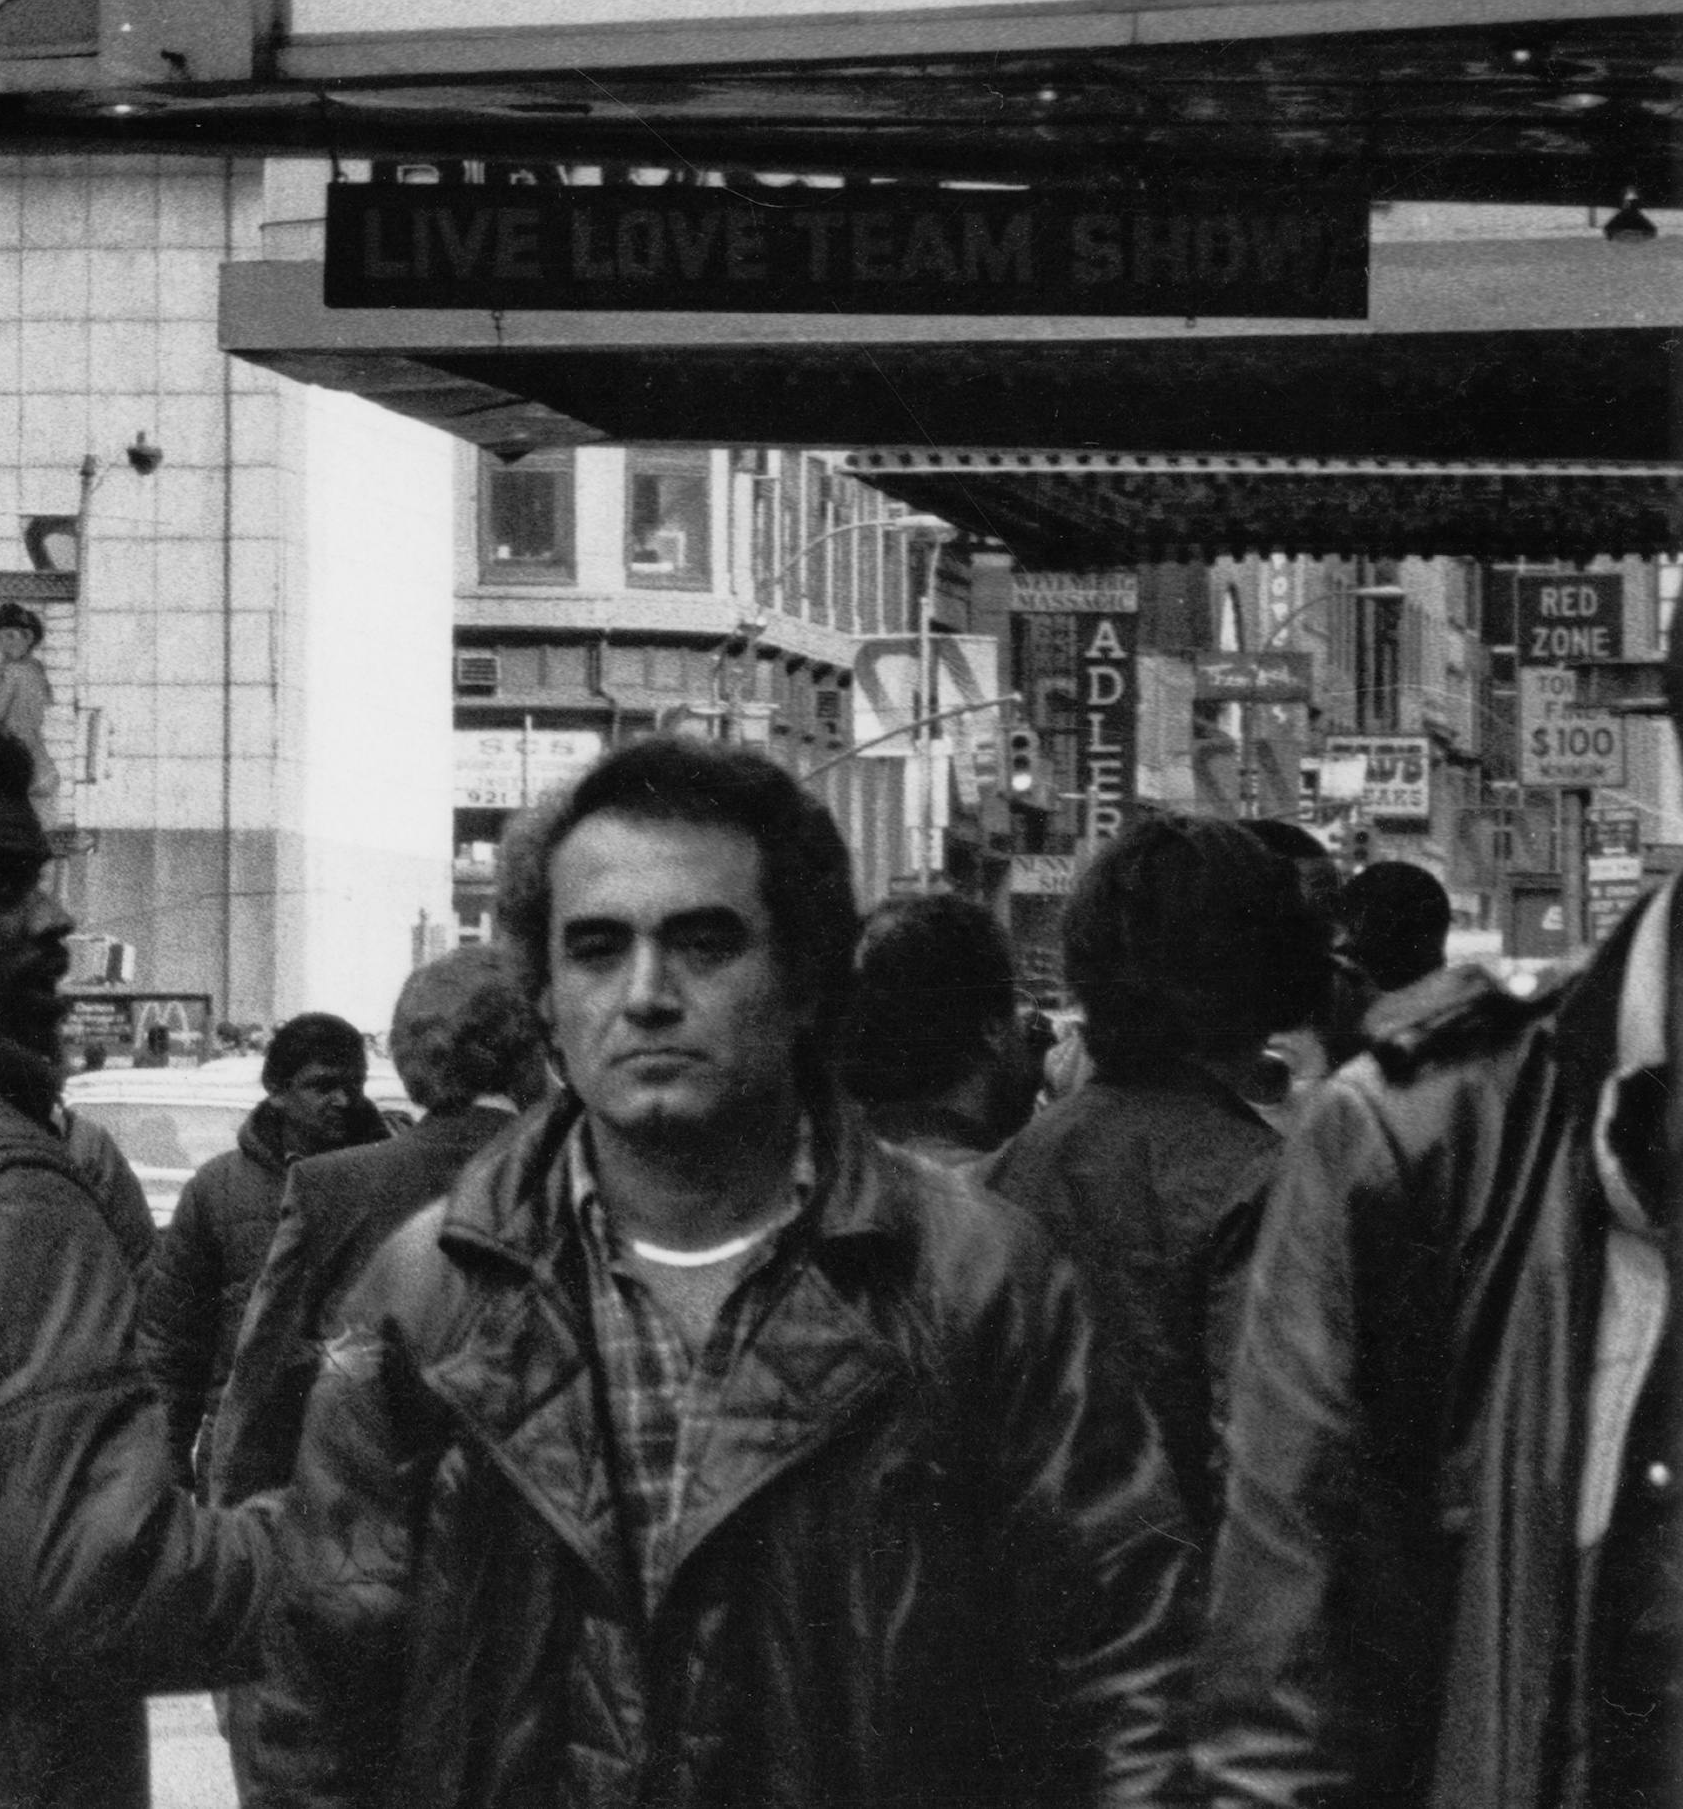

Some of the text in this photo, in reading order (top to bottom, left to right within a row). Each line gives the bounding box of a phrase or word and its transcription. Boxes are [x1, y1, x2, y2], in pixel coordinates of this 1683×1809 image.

[364, 208, 1325, 287] LIVE LOVE TEAM SHOW
[1541, 586, 1598, 616] RED
[1532, 627, 1610, 657] ZONE
[1085, 620, 1127, 838] ADLER
[1532, 727, 1614, 757] $100
